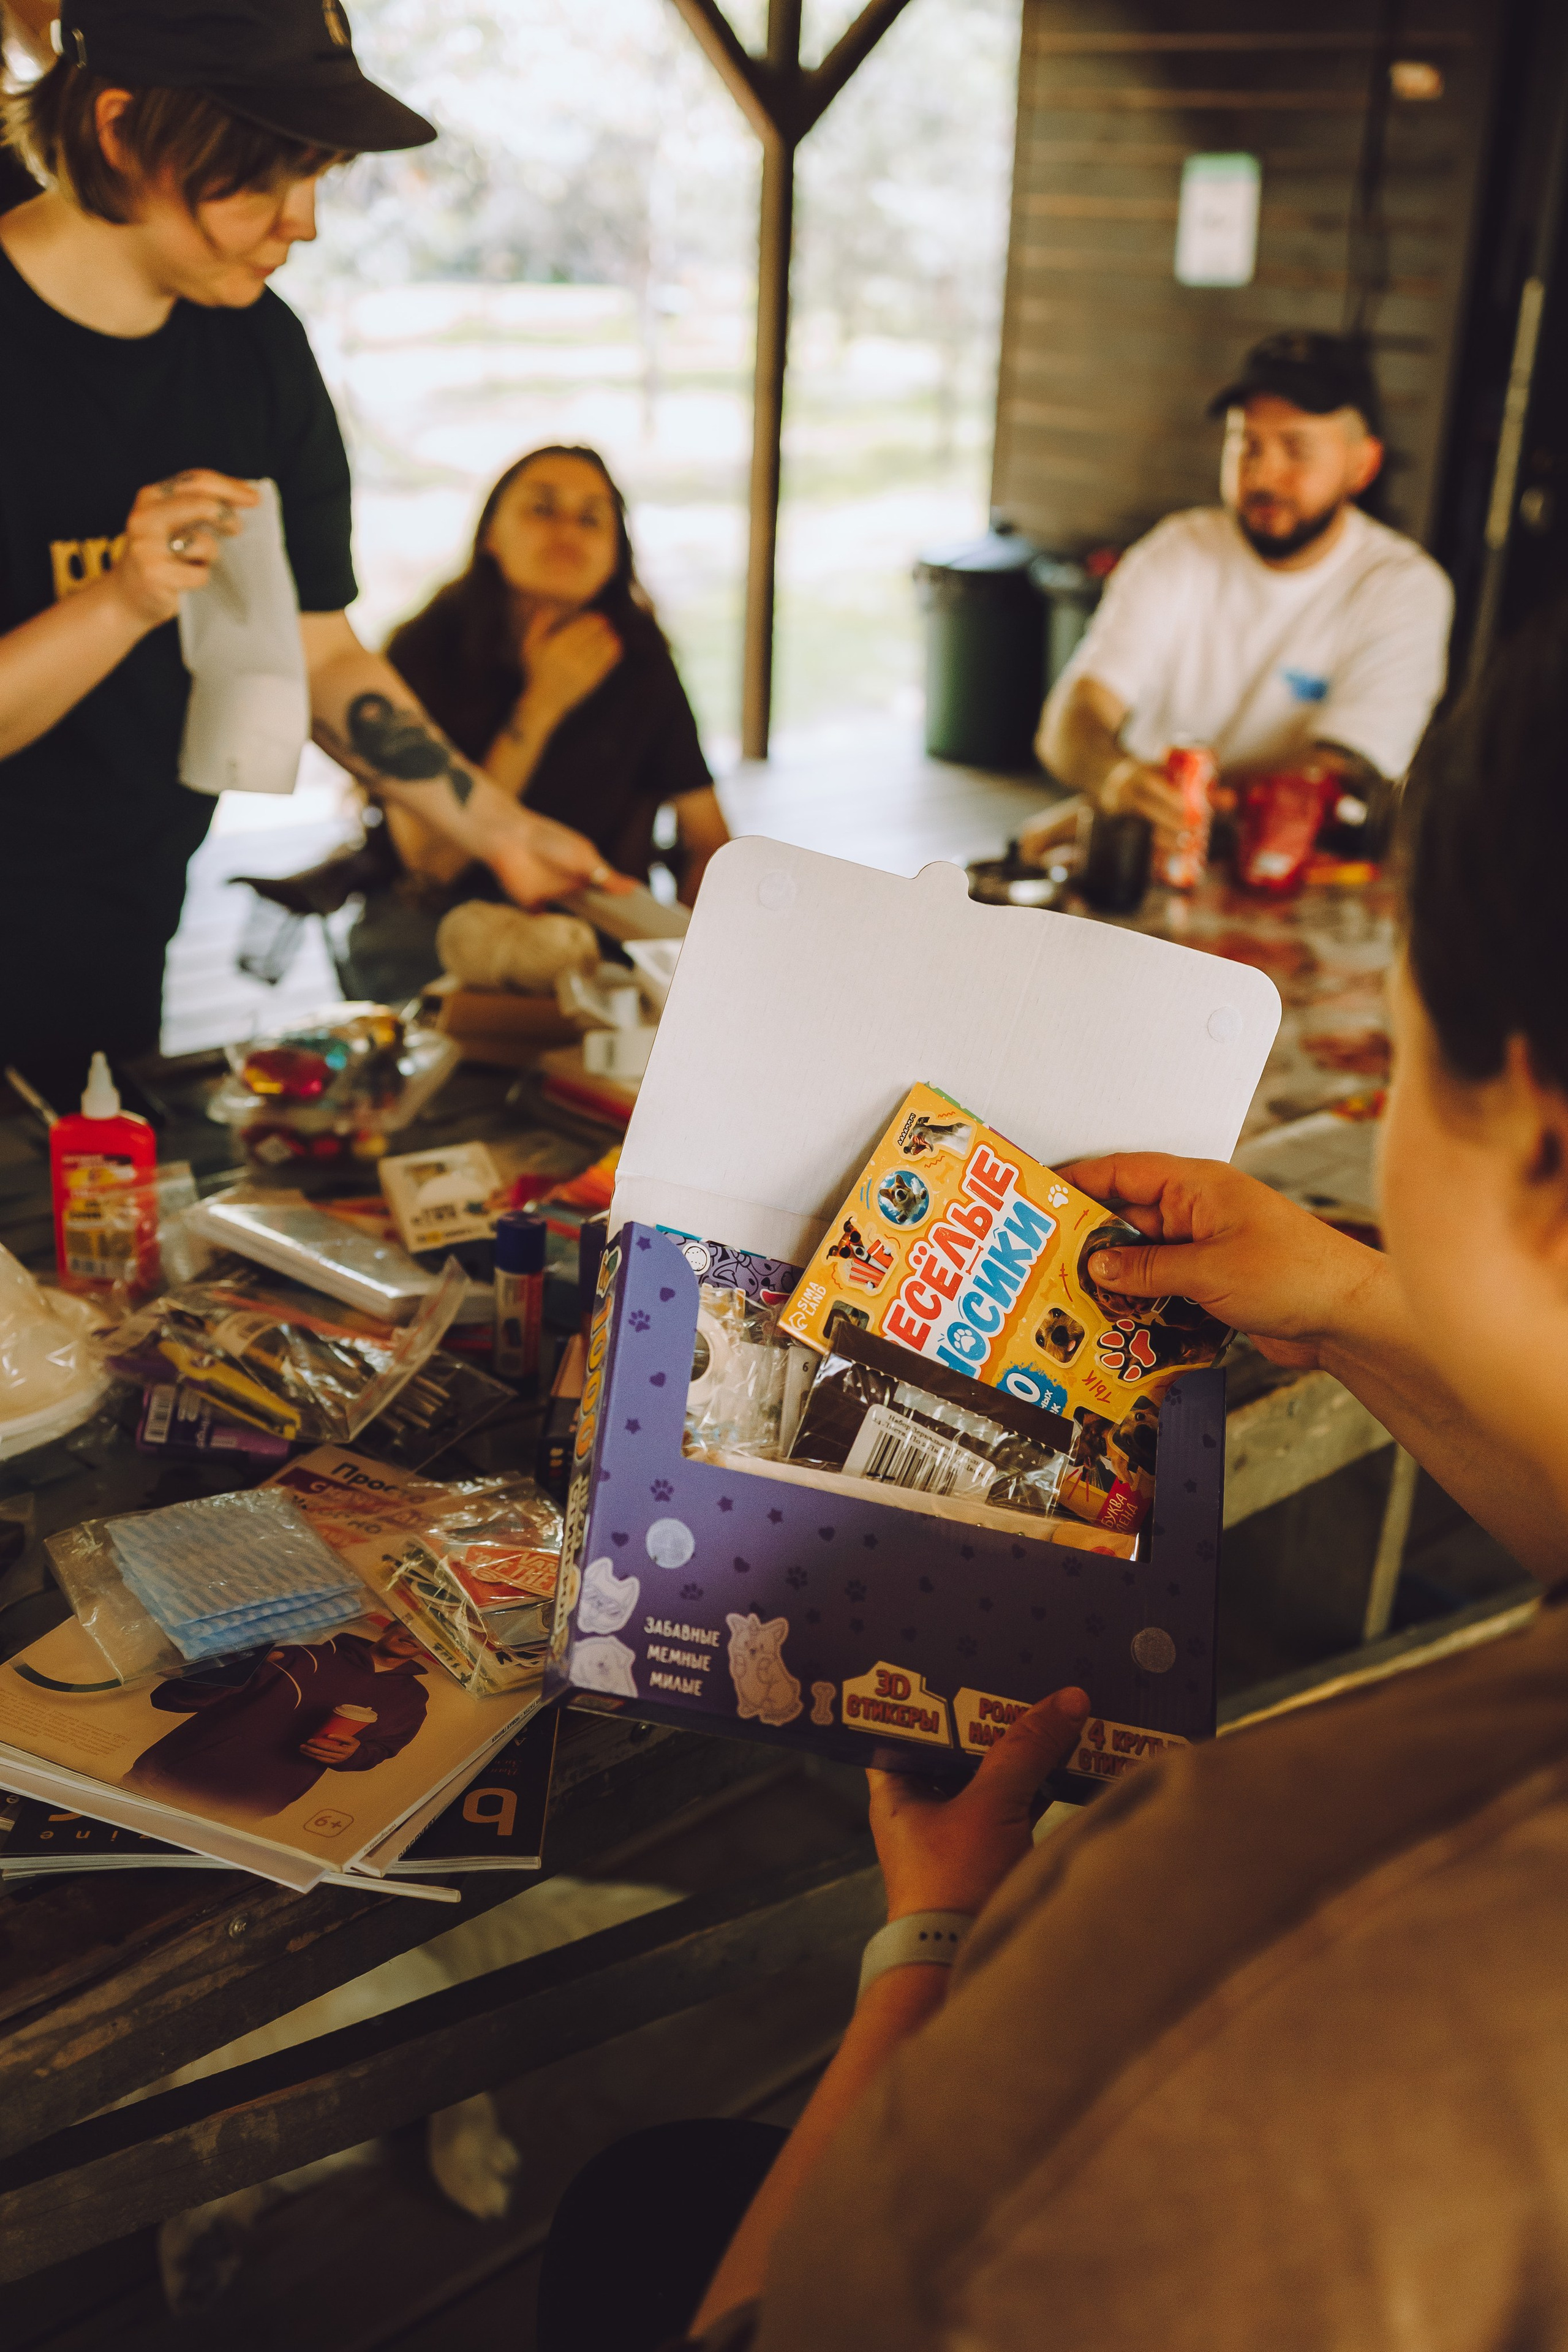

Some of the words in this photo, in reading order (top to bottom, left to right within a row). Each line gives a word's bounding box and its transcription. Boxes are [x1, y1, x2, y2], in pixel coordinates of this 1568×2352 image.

[887, 1149, 1015, 1352] ЕСЁЛЫЕ
[797, 1281, 819, 1311] SIMA
[805, 1286, 826, 1317] LAND
[802, 1362, 809, 1372] 6
[1082, 1370, 1112, 1404] ТЫК
[331, 1461, 426, 1506] Просо
[1101, 1493, 1128, 1529] БУКВА
[1116, 1502, 1139, 1531] ЛЕНД
[644, 1616, 720, 1648] ЗАБАВНЫЕ
[647, 1644, 712, 1672] МЕМНЫЕ
[649, 1671, 703, 1697] МИЛЫЕ
[875, 1668, 911, 1701] 3D
[507, 1717, 520, 1730] НОВАЯ
[524, 1703, 536, 1716] ПАПУА
[846, 1694, 940, 1734] СТИКЕРЫ
[491, 1727, 507, 1743] ГВИНЕЯ
[1088, 1719, 1106, 1750] 4
[314, 1815, 342, 1828] 6+
